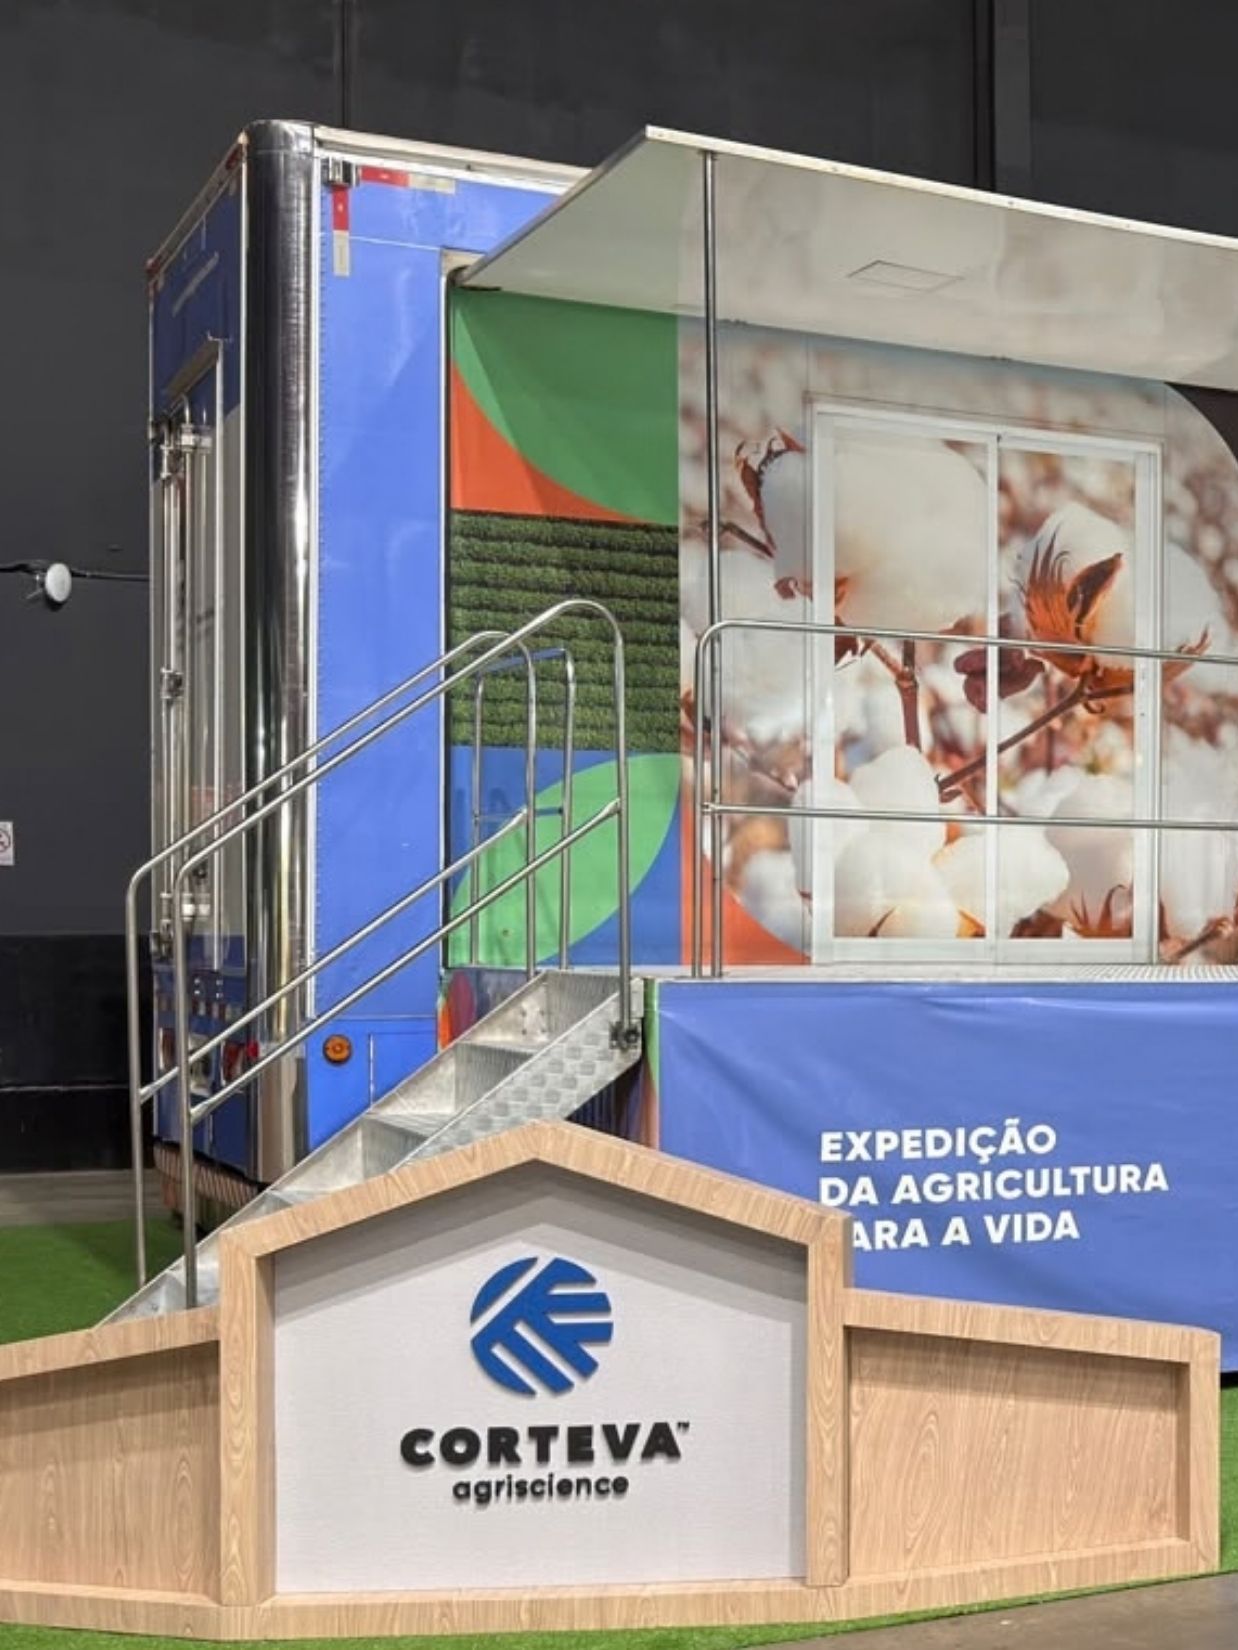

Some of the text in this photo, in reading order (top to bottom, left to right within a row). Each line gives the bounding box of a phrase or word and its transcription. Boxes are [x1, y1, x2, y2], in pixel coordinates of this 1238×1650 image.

[820, 1118, 1057, 1164] EXPEDIÇÃO
[819, 1163, 1170, 1207] DA AGRICULTURA
[853, 1210, 1080, 1252] ARA A VIDA
[452, 1473, 629, 1506] agriscience
